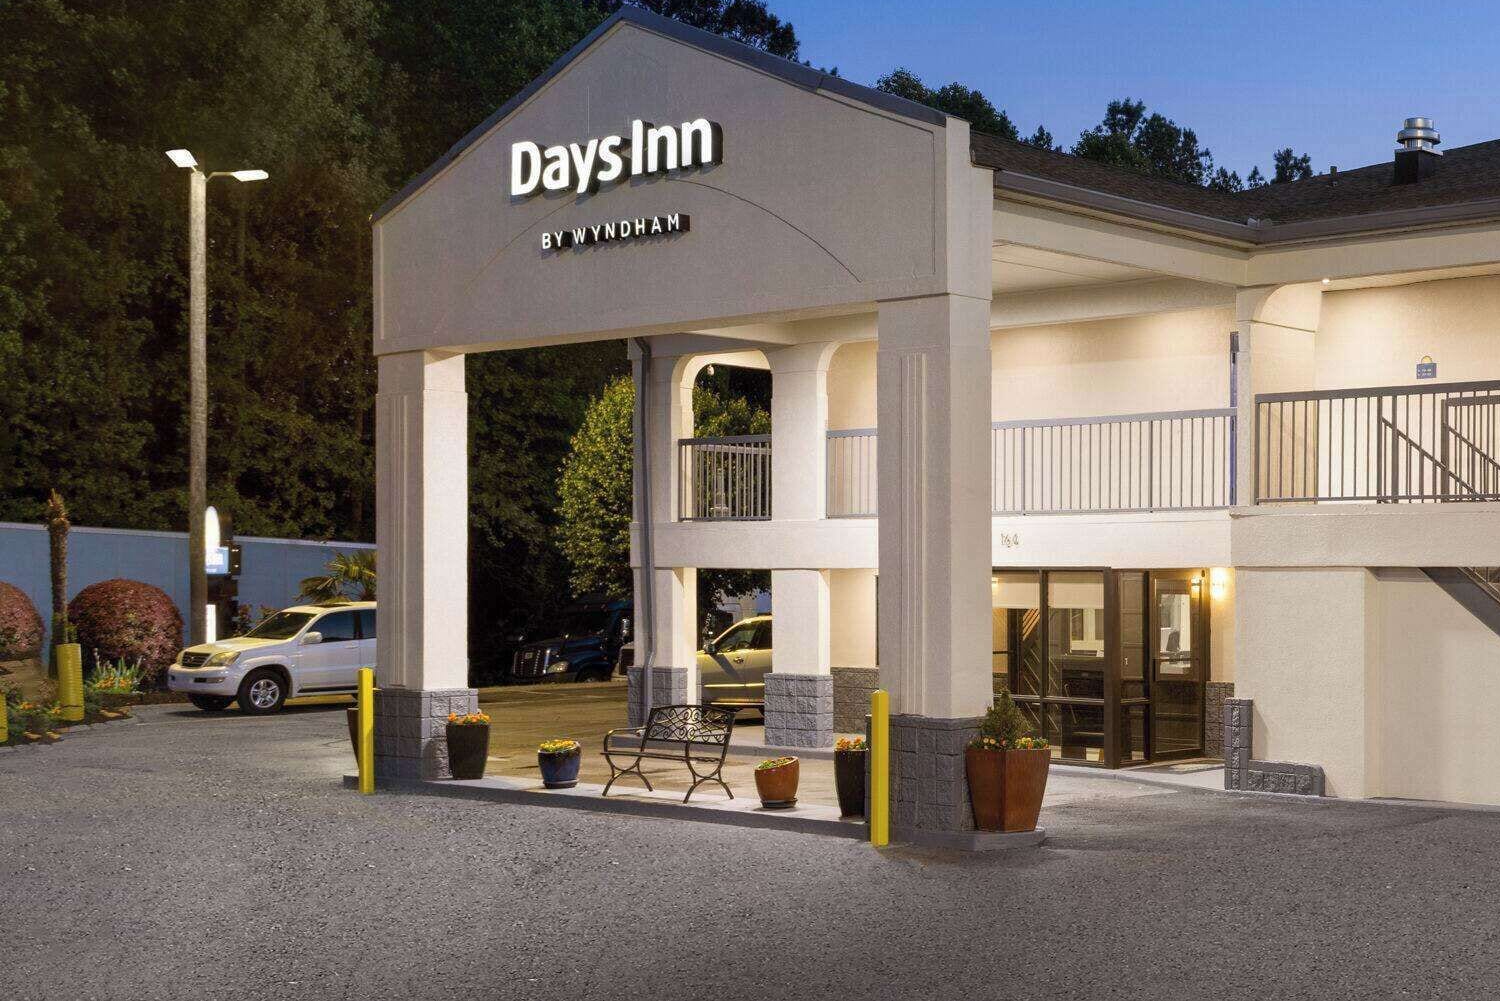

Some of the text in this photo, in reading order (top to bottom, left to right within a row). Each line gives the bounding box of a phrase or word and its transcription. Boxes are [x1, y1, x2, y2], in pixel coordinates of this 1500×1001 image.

[511, 118, 712, 196] Days Inn
[542, 212, 680, 250] BY WYNDHAM
